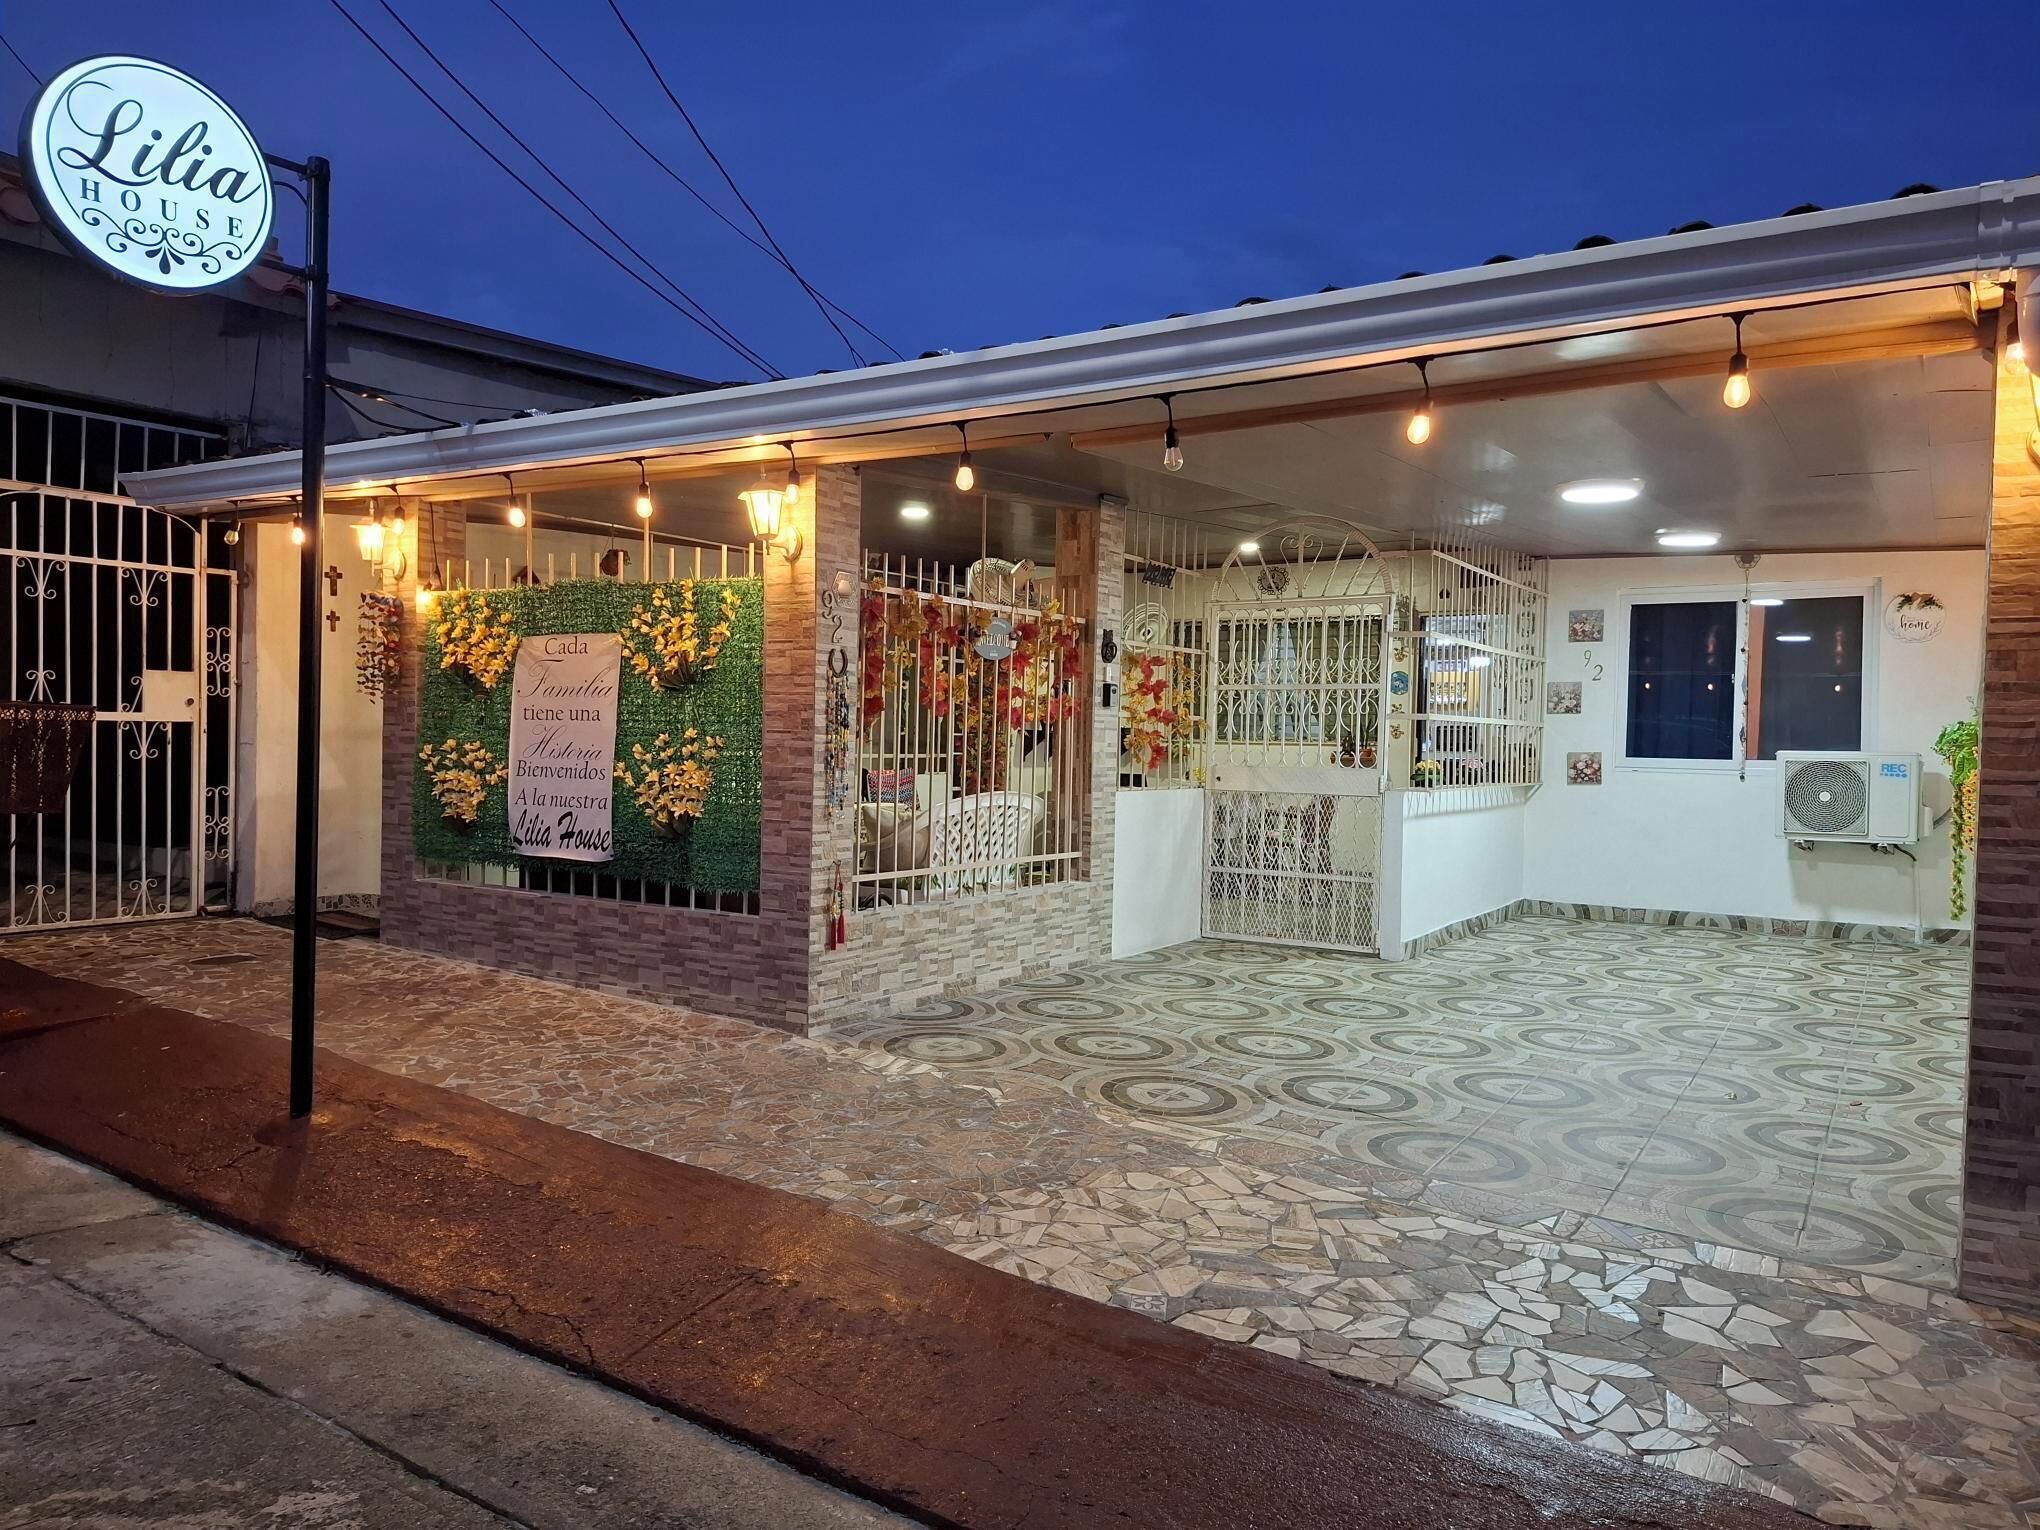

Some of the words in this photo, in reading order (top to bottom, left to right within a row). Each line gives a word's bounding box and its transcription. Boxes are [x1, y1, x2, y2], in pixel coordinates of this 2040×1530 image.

[57, 81, 262, 203] Lilia
[79, 177, 243, 239] HOUSE
[1900, 614, 1931, 631] home
[544, 635, 589, 655] Cada
[516, 659, 614, 698] Familia
[523, 704, 565, 721] tiene
[569, 707, 601, 721] una
[522, 723, 603, 760] Historia
[515, 759, 607, 780] Bienvenidos
[1881, 763, 1907, 774] REC
[514, 787, 528, 805] A
[532, 787, 547, 806] la
[550, 794, 608, 810] nuestra
[513, 808, 552, 848] Lilia
[557, 811, 611, 852] House
